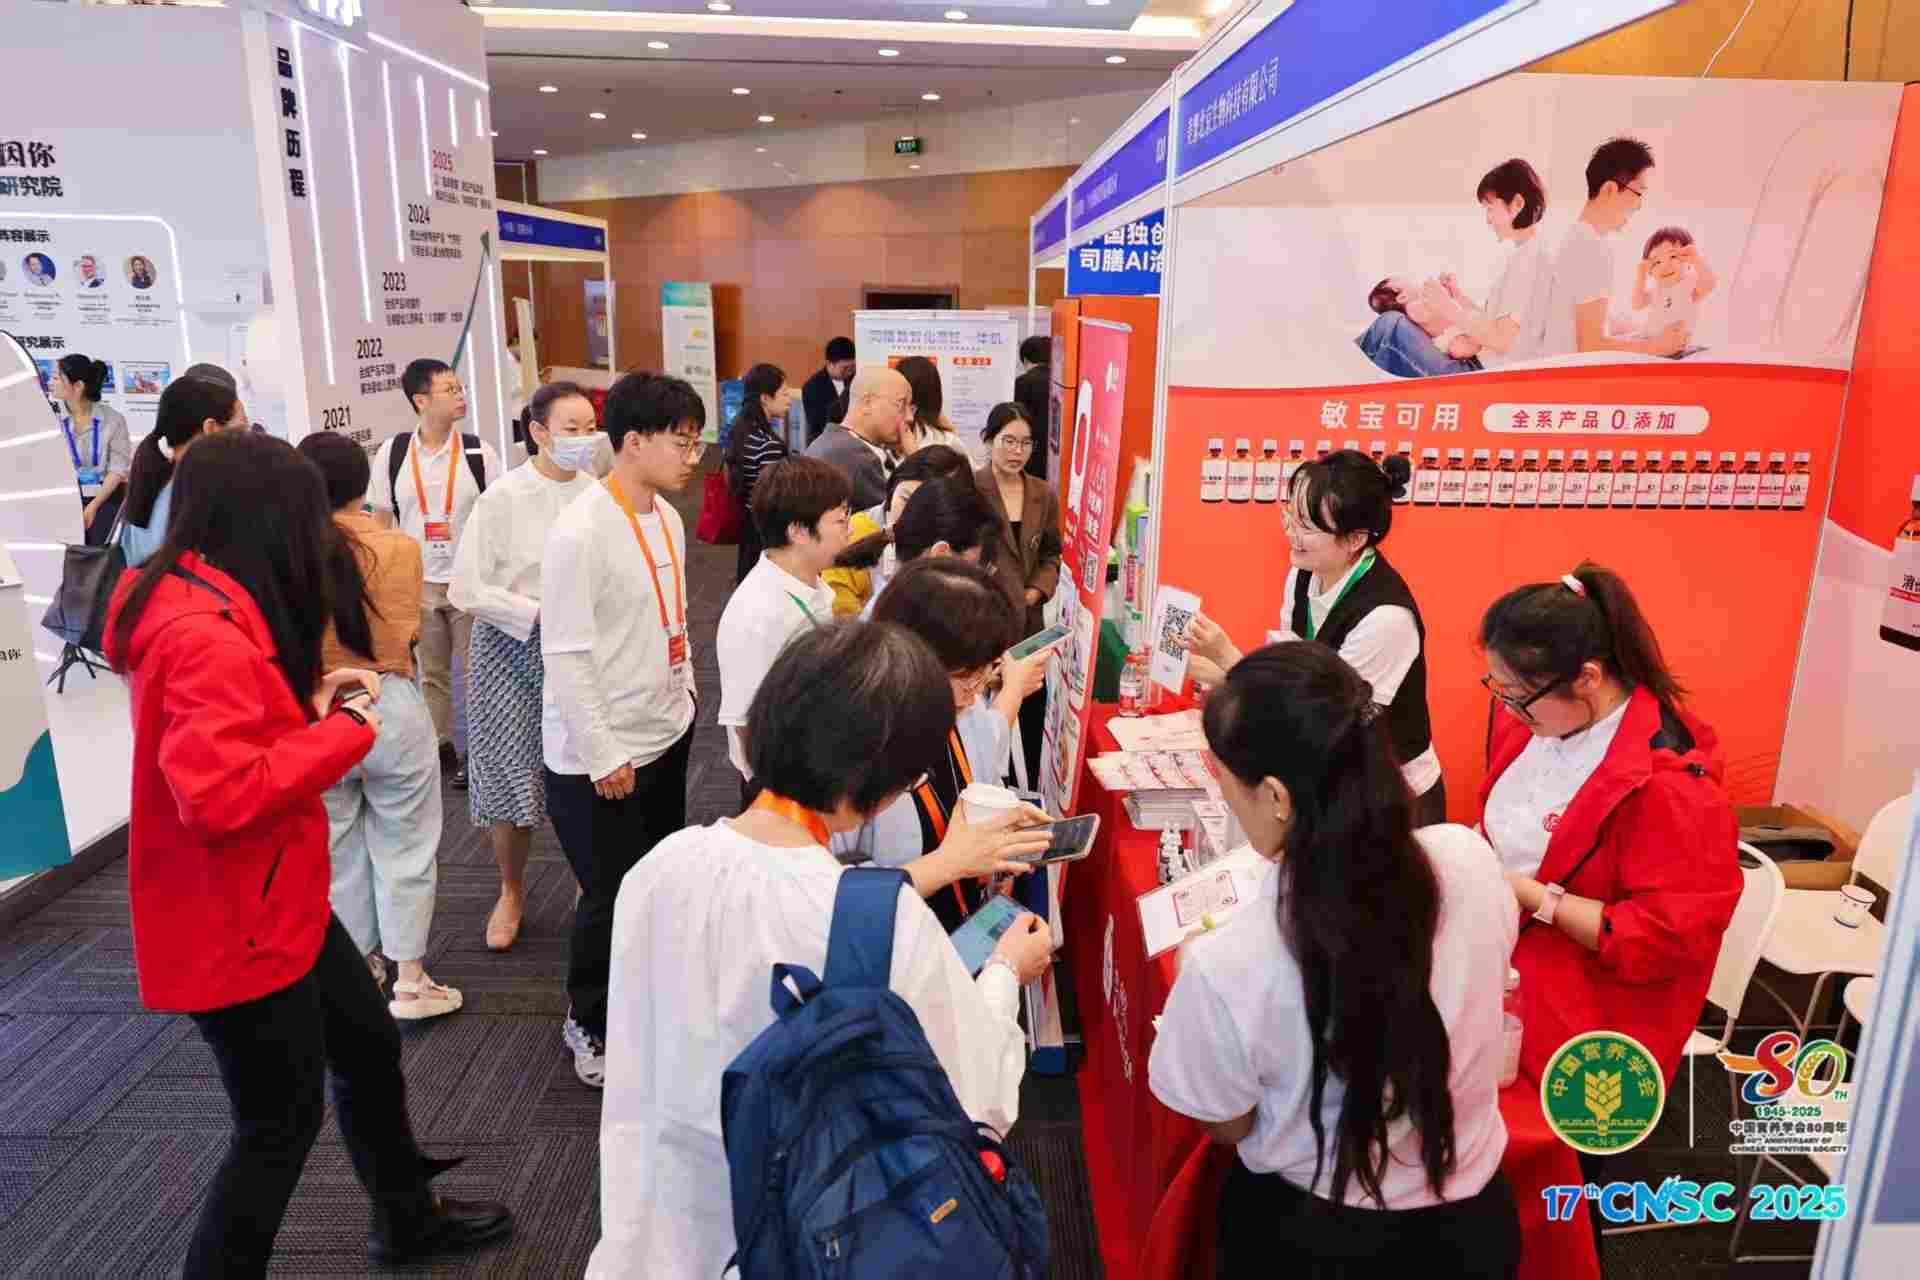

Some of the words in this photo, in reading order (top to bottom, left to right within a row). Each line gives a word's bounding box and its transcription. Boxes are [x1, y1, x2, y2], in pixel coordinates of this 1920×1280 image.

[277, 47, 306, 197] 品牌历程
[433, 149, 453, 173] 2025
[0, 176, 63, 197] 研究院
[408, 203, 430, 224] 2024
[1086, 221, 1167, 246] 国独创
[383, 271, 406, 291] 2023
[357, 338, 383, 359] 2022
[323, 405, 351, 429] 2021
[1320, 400, 1461, 431] 敏宝可用
